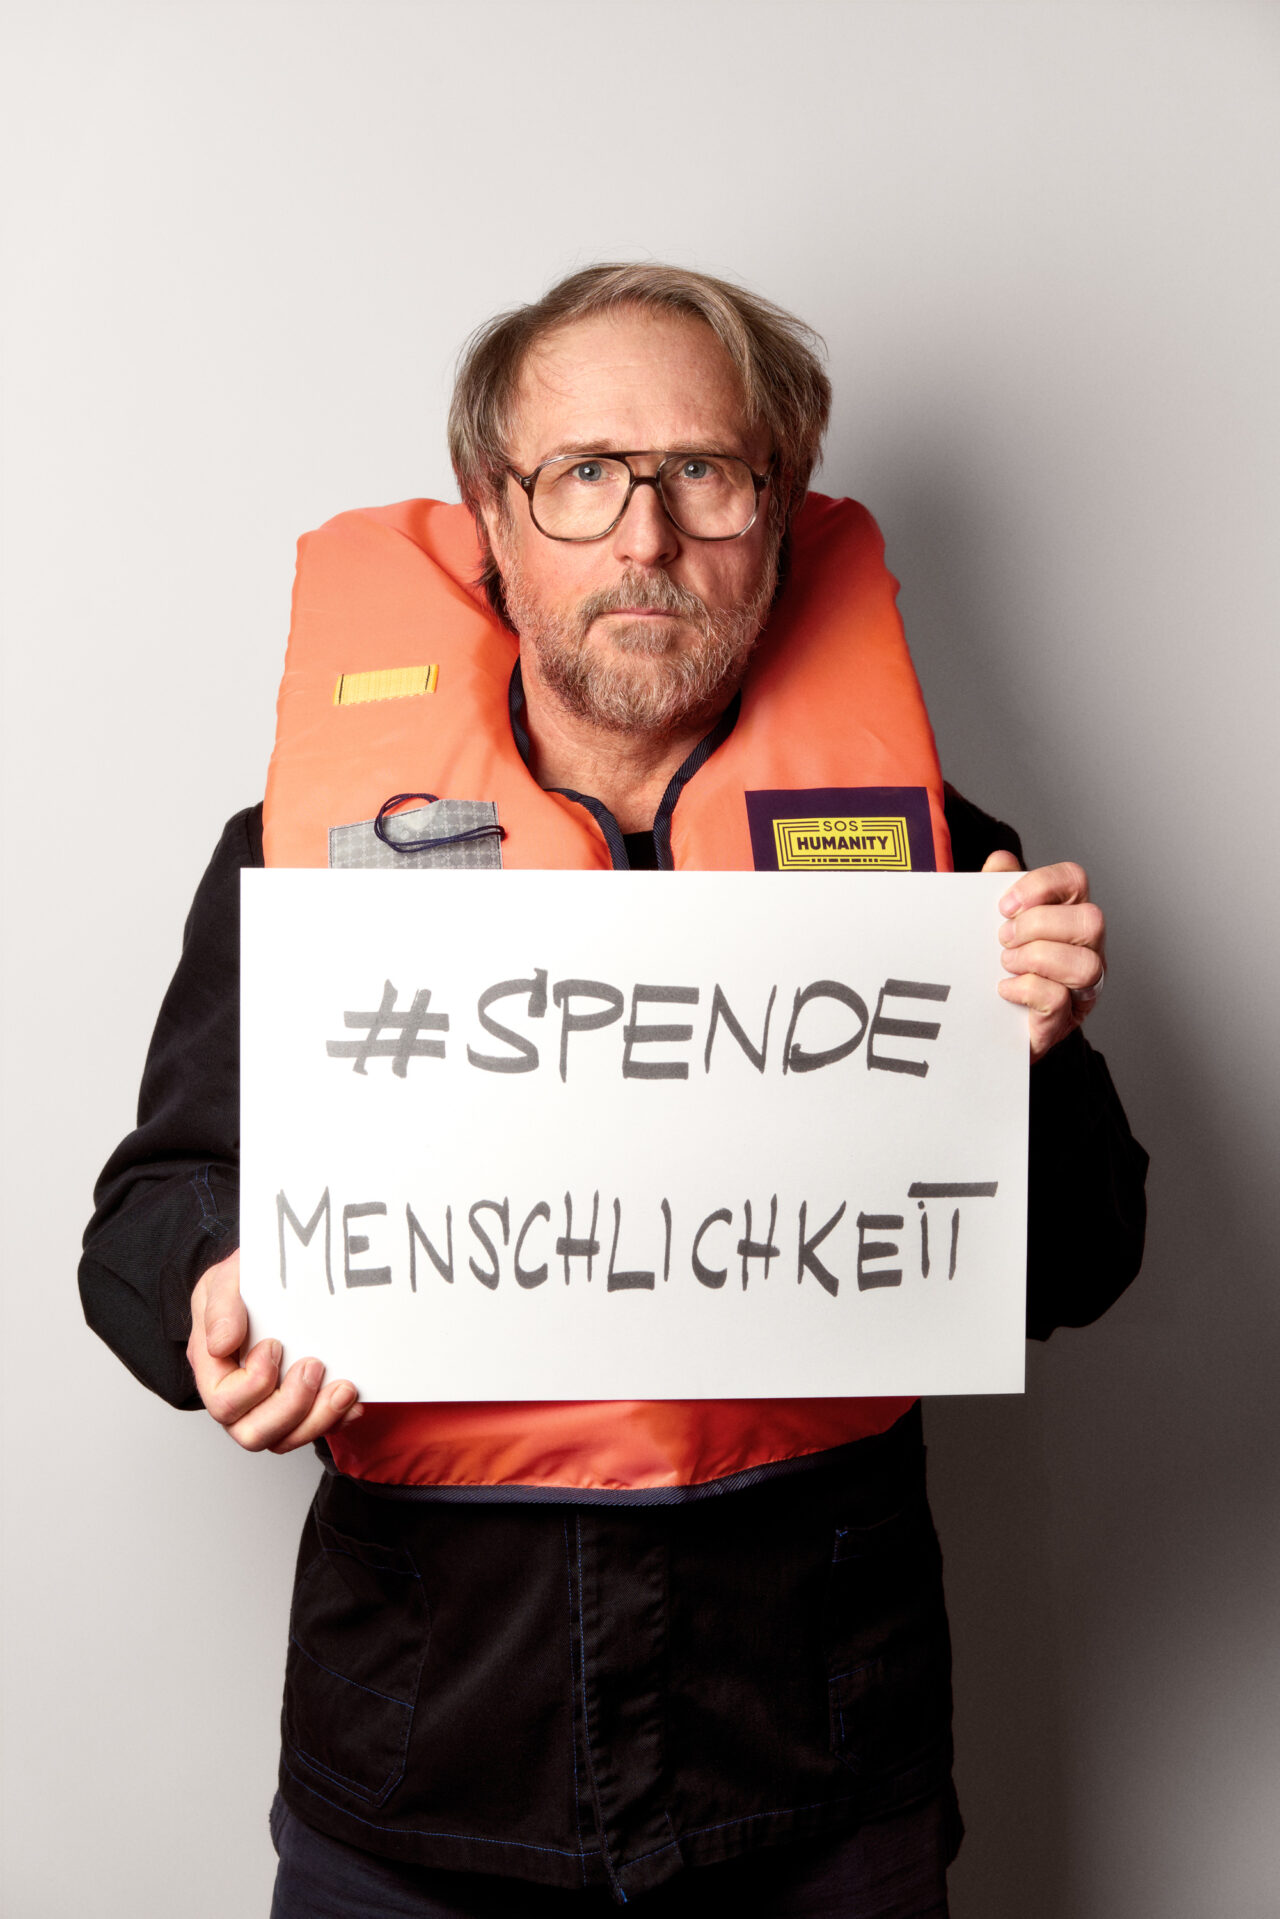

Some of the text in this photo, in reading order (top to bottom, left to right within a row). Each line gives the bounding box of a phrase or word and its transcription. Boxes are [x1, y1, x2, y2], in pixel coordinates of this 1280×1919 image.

[823, 820, 859, 832] SOS
[797, 836, 888, 850] HUMANITY
[325, 968, 951, 1083] #SPENDE
